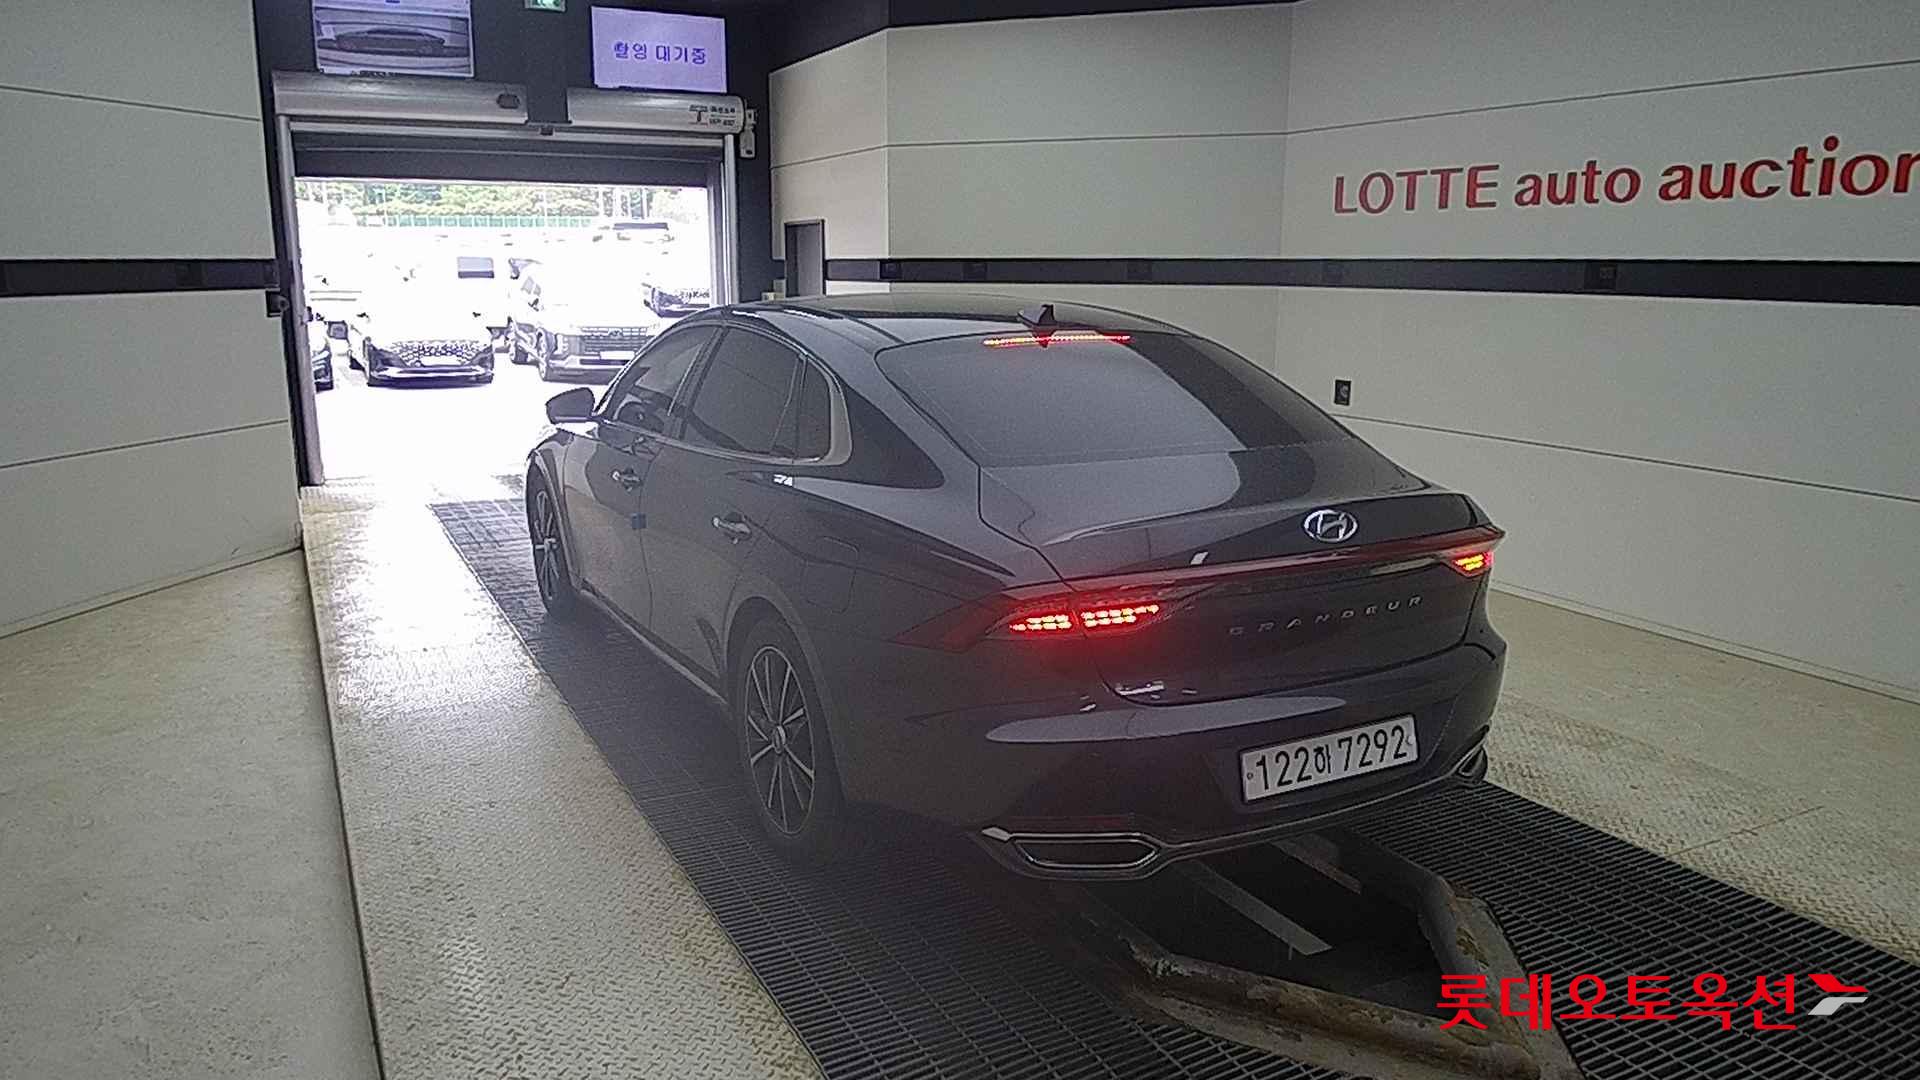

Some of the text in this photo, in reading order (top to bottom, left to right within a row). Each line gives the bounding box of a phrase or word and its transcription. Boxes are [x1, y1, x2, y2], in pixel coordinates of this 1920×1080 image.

[655, 45, 706, 65] 대기중
[1334, 163, 1500, 215] LOTTE
[1513, 160, 1641, 206] auto
[1229, 595, 1422, 636] GRANDEUR
